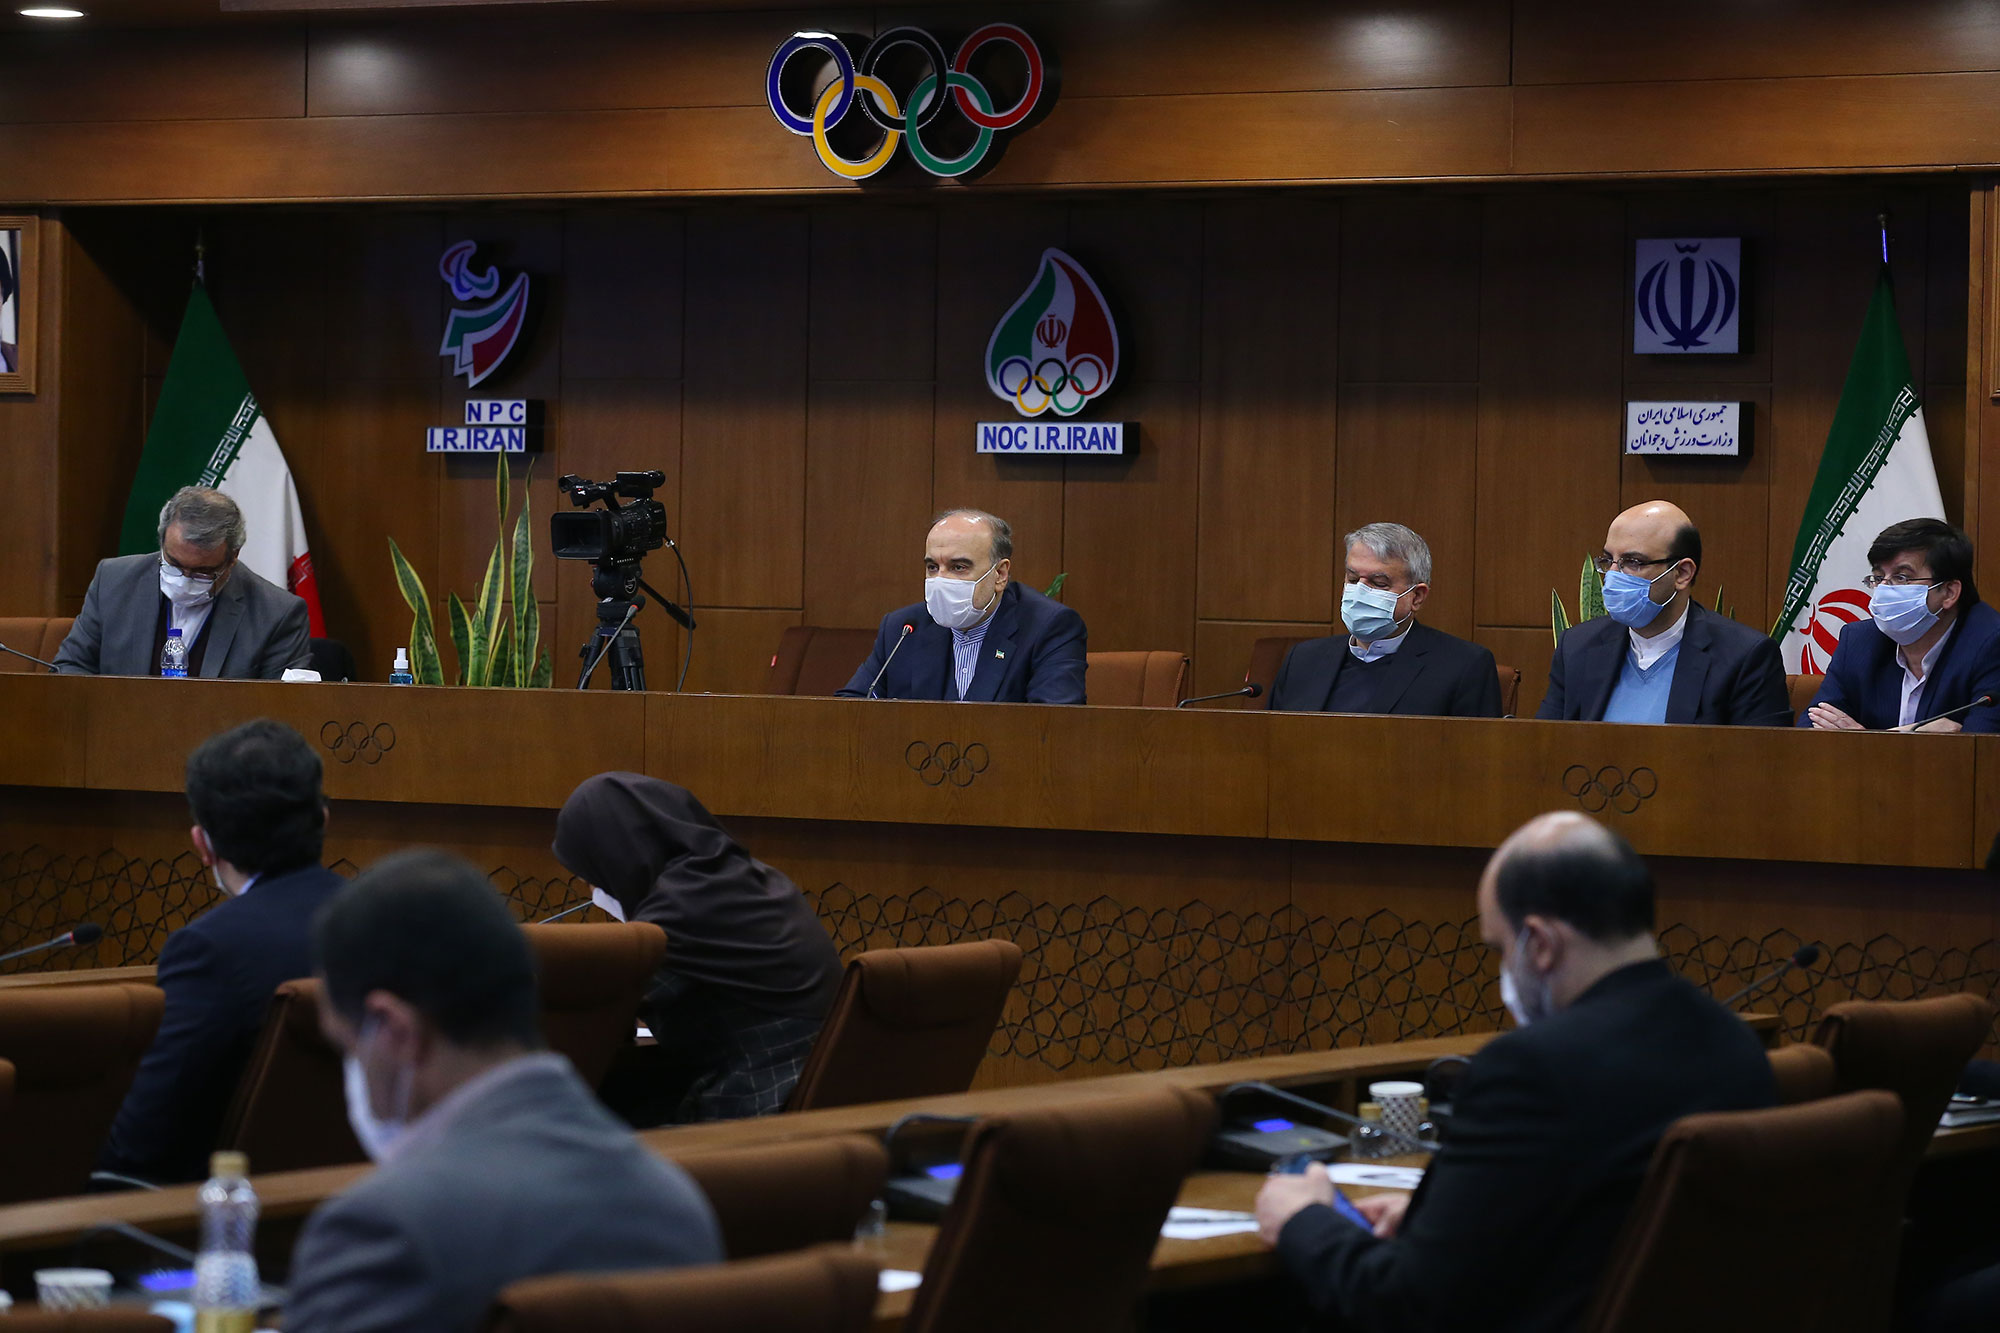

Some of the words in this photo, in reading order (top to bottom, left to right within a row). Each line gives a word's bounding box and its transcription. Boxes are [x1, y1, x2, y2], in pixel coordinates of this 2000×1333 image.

[429, 428, 523, 450] I.R.IRAN
[983, 426, 1028, 450] NOC
[1035, 426, 1117, 451] I.R.IRAN
